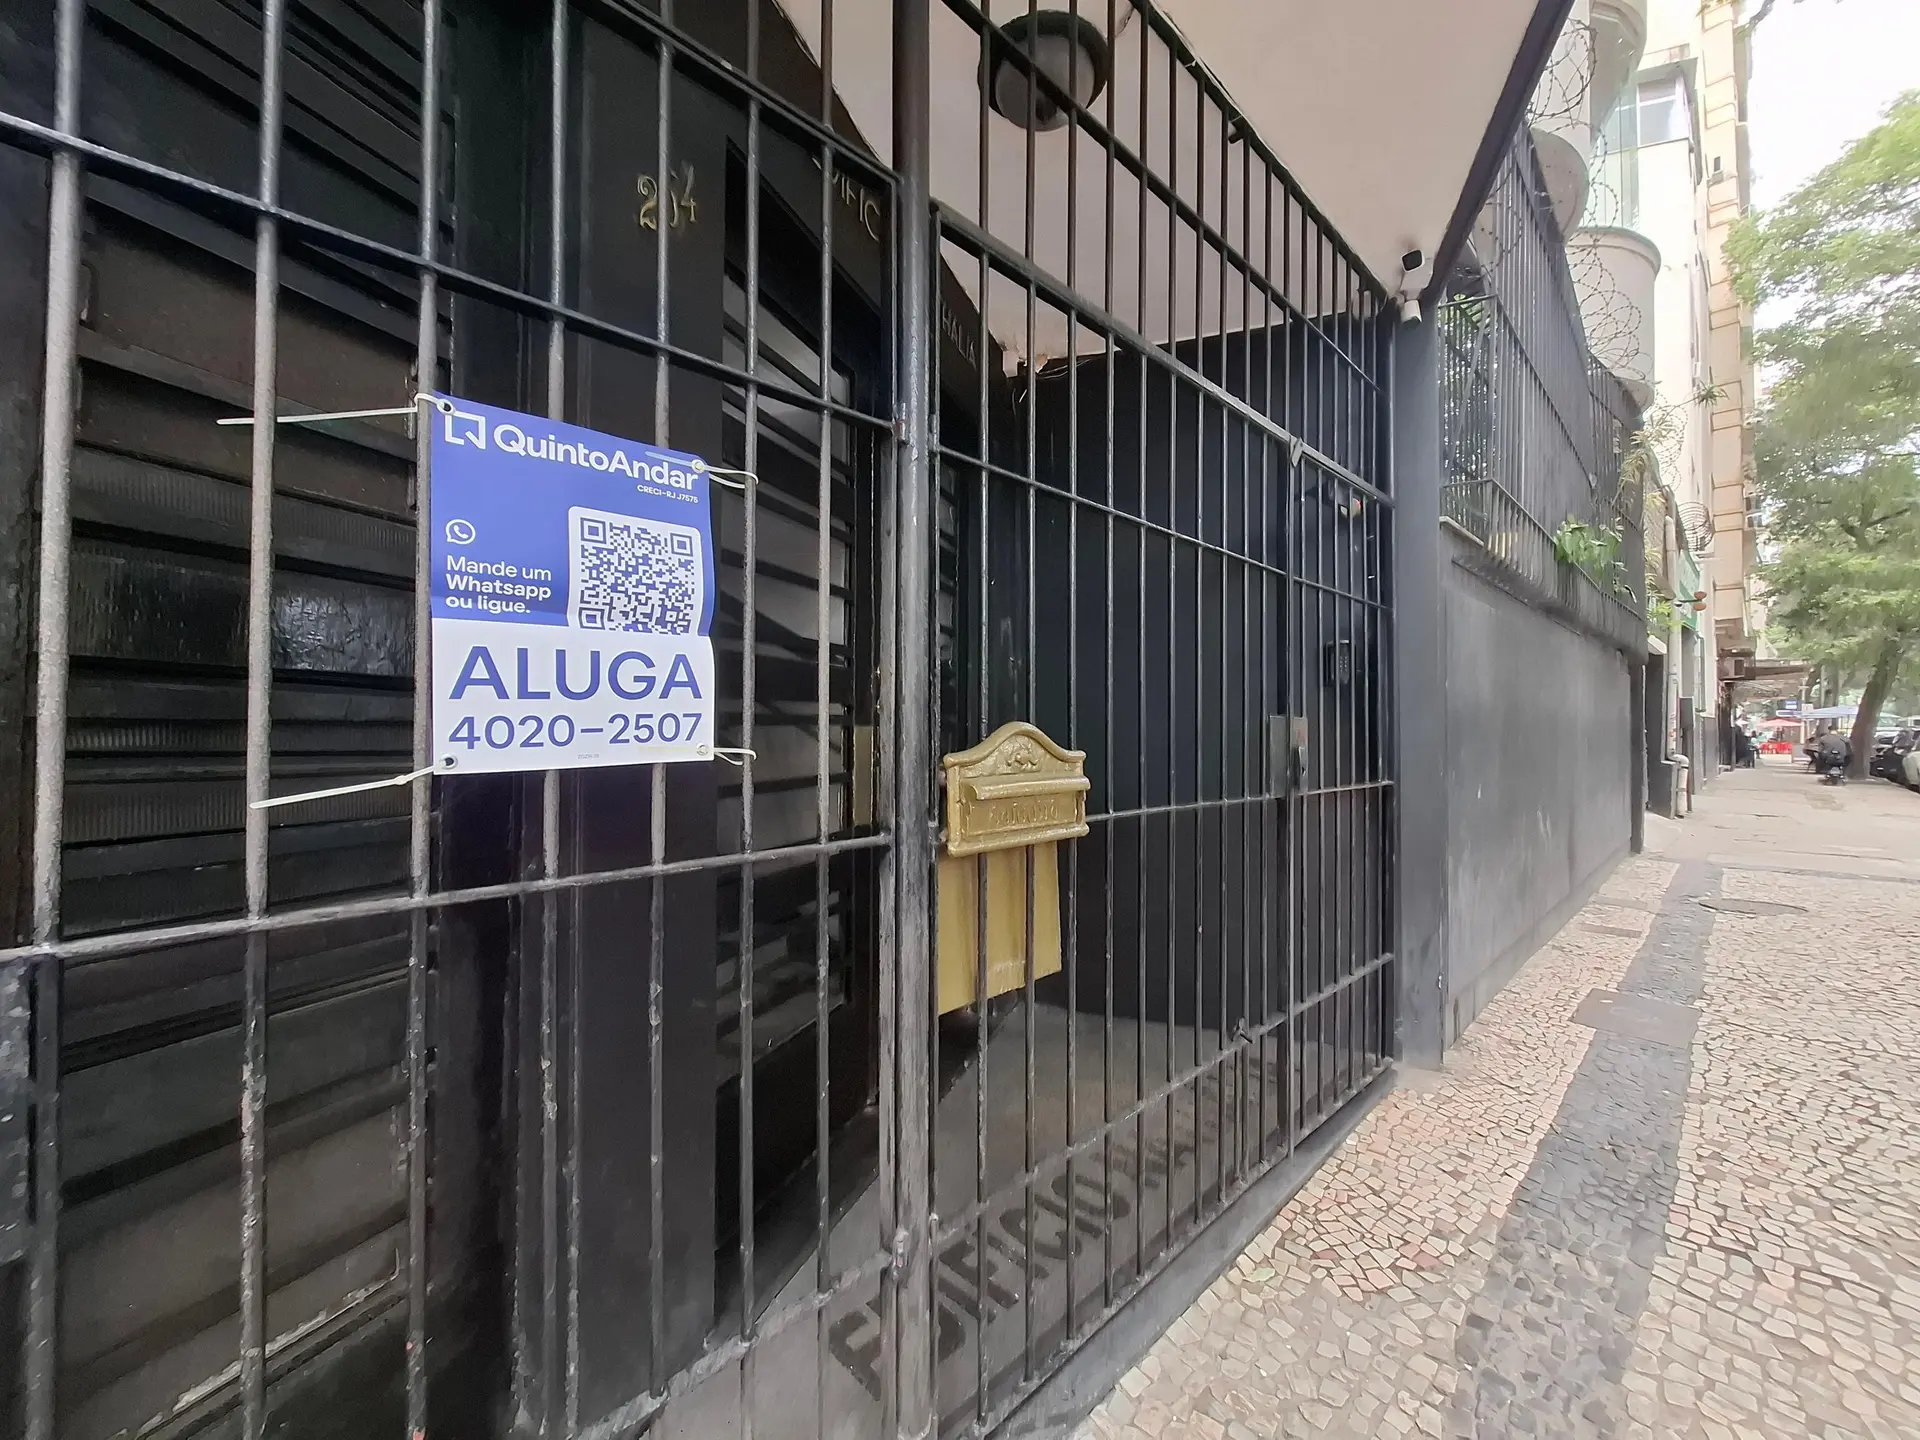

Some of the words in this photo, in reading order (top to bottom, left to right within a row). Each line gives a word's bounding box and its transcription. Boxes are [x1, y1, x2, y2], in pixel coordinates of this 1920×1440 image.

[493, 423, 699, 491] QuintoAndar
[636, 484, 676, 499] CRECI-RJ
[446, 554, 518, 578] Mande
[521, 566, 552, 582] um
[445, 573, 552, 600] Whatsapp
[445, 596, 473, 609] ou
[476, 594, 532, 615] ligue.
[448, 645, 703, 701] ALUGA
[448, 712, 703, 750] 4020-2507
